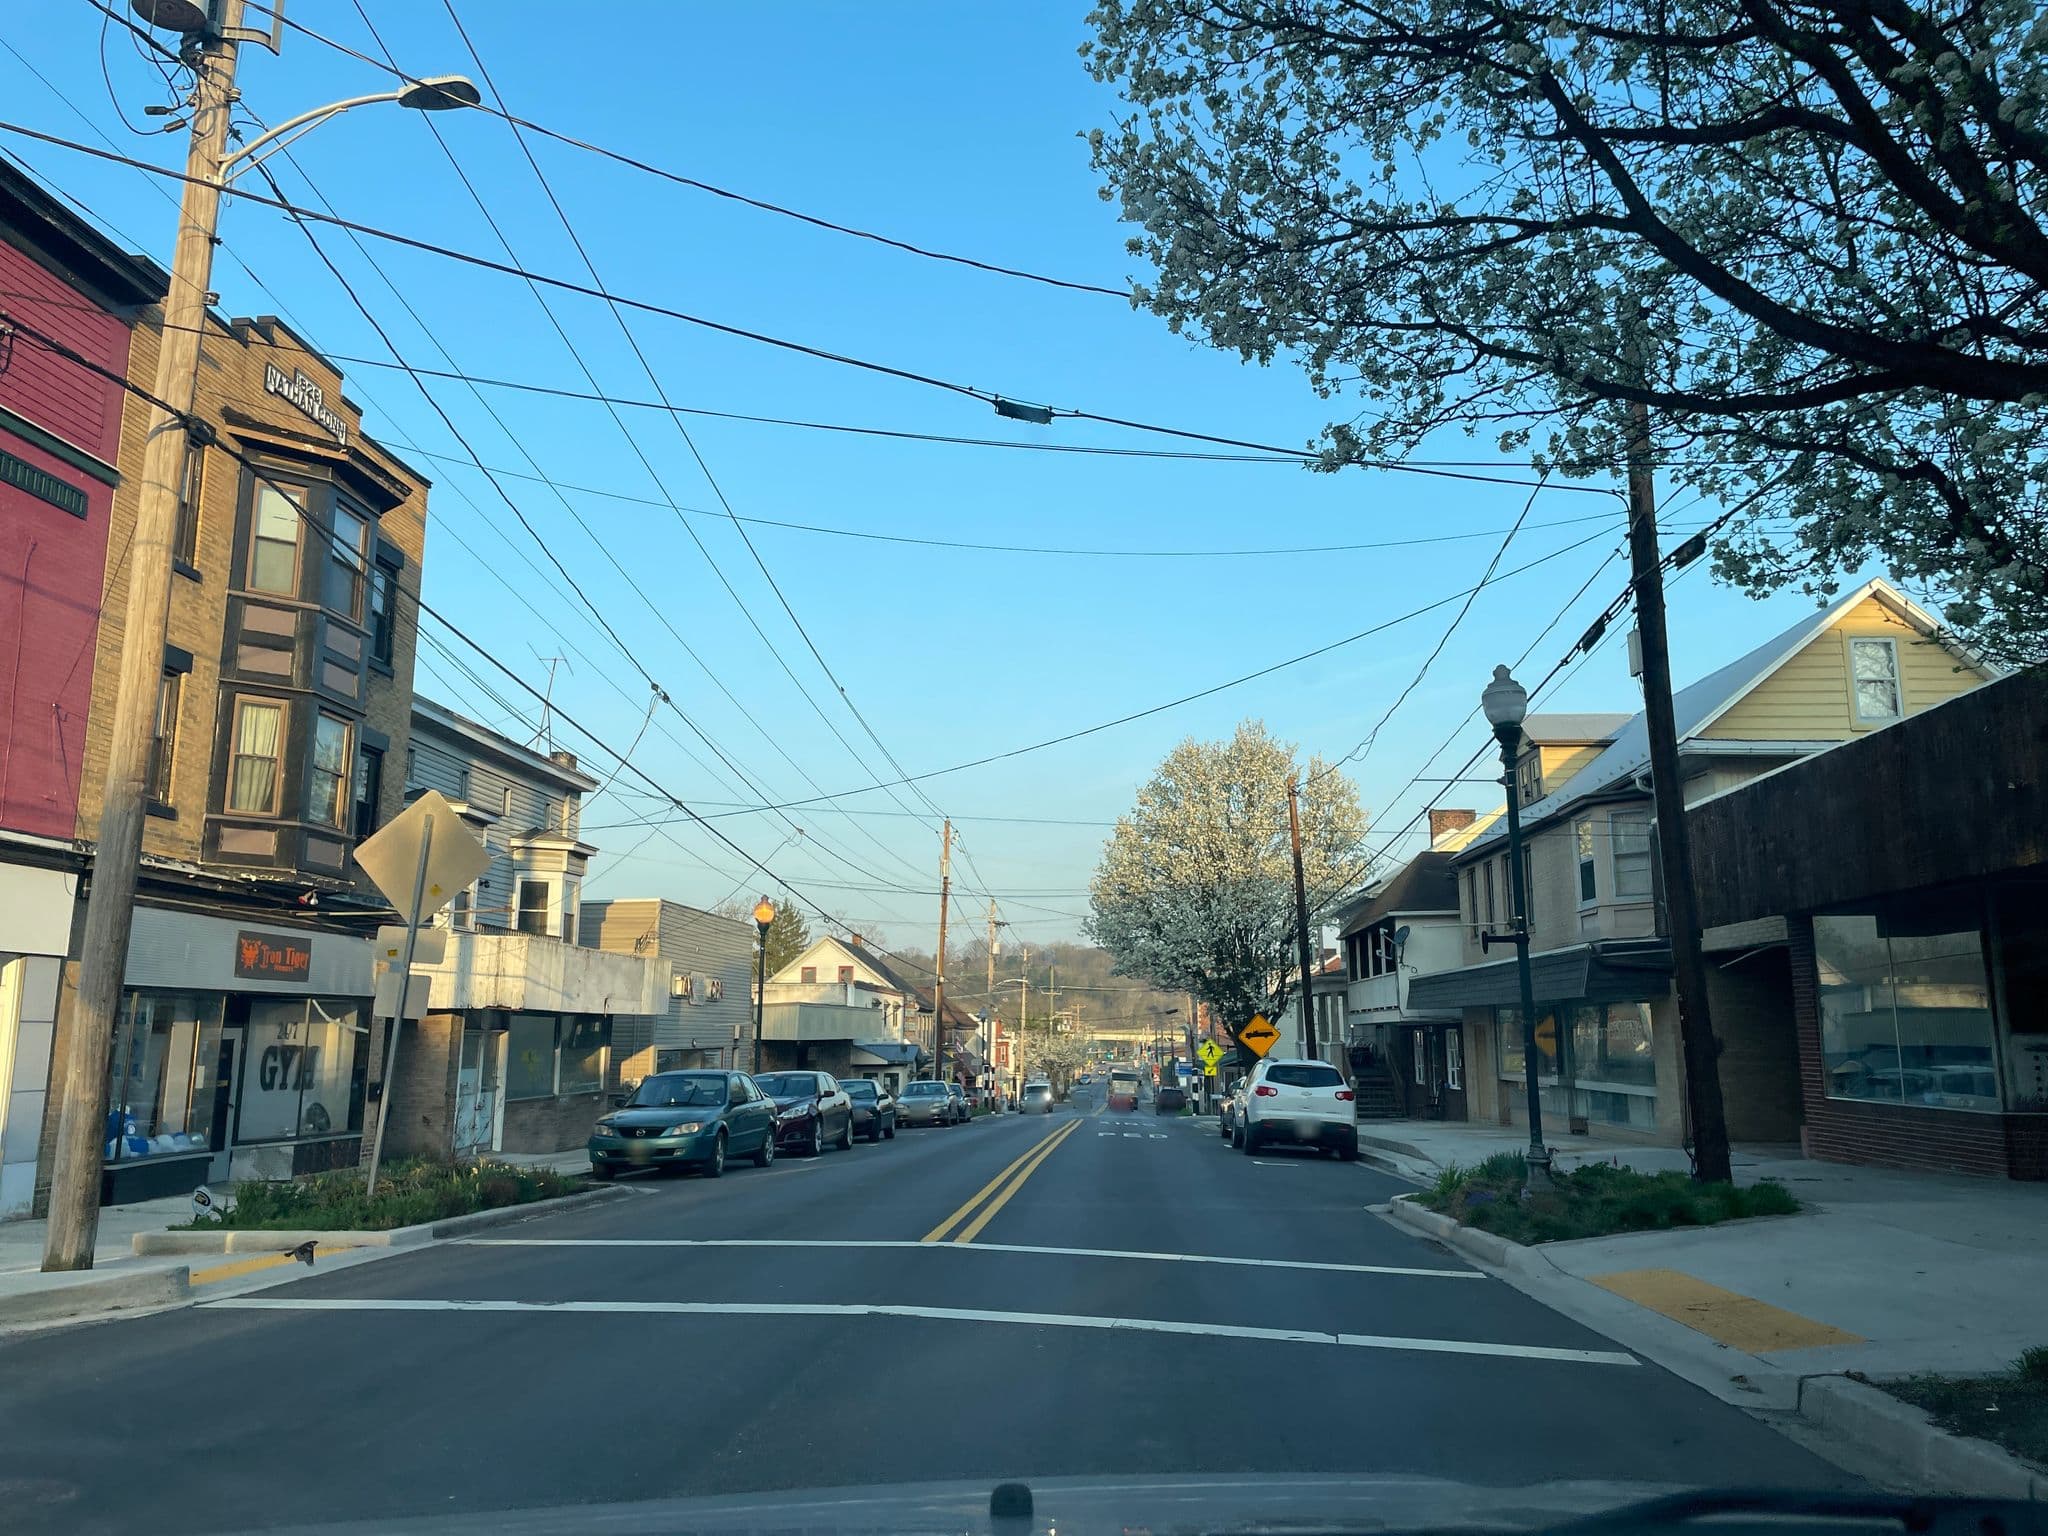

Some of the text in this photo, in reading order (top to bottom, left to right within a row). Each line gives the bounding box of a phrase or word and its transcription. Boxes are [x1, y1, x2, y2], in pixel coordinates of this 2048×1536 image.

[268, 365, 313, 414] NATHAN
[260, 944, 309, 970] Iron Tiger
[260, 1045, 320, 1091] GYM
